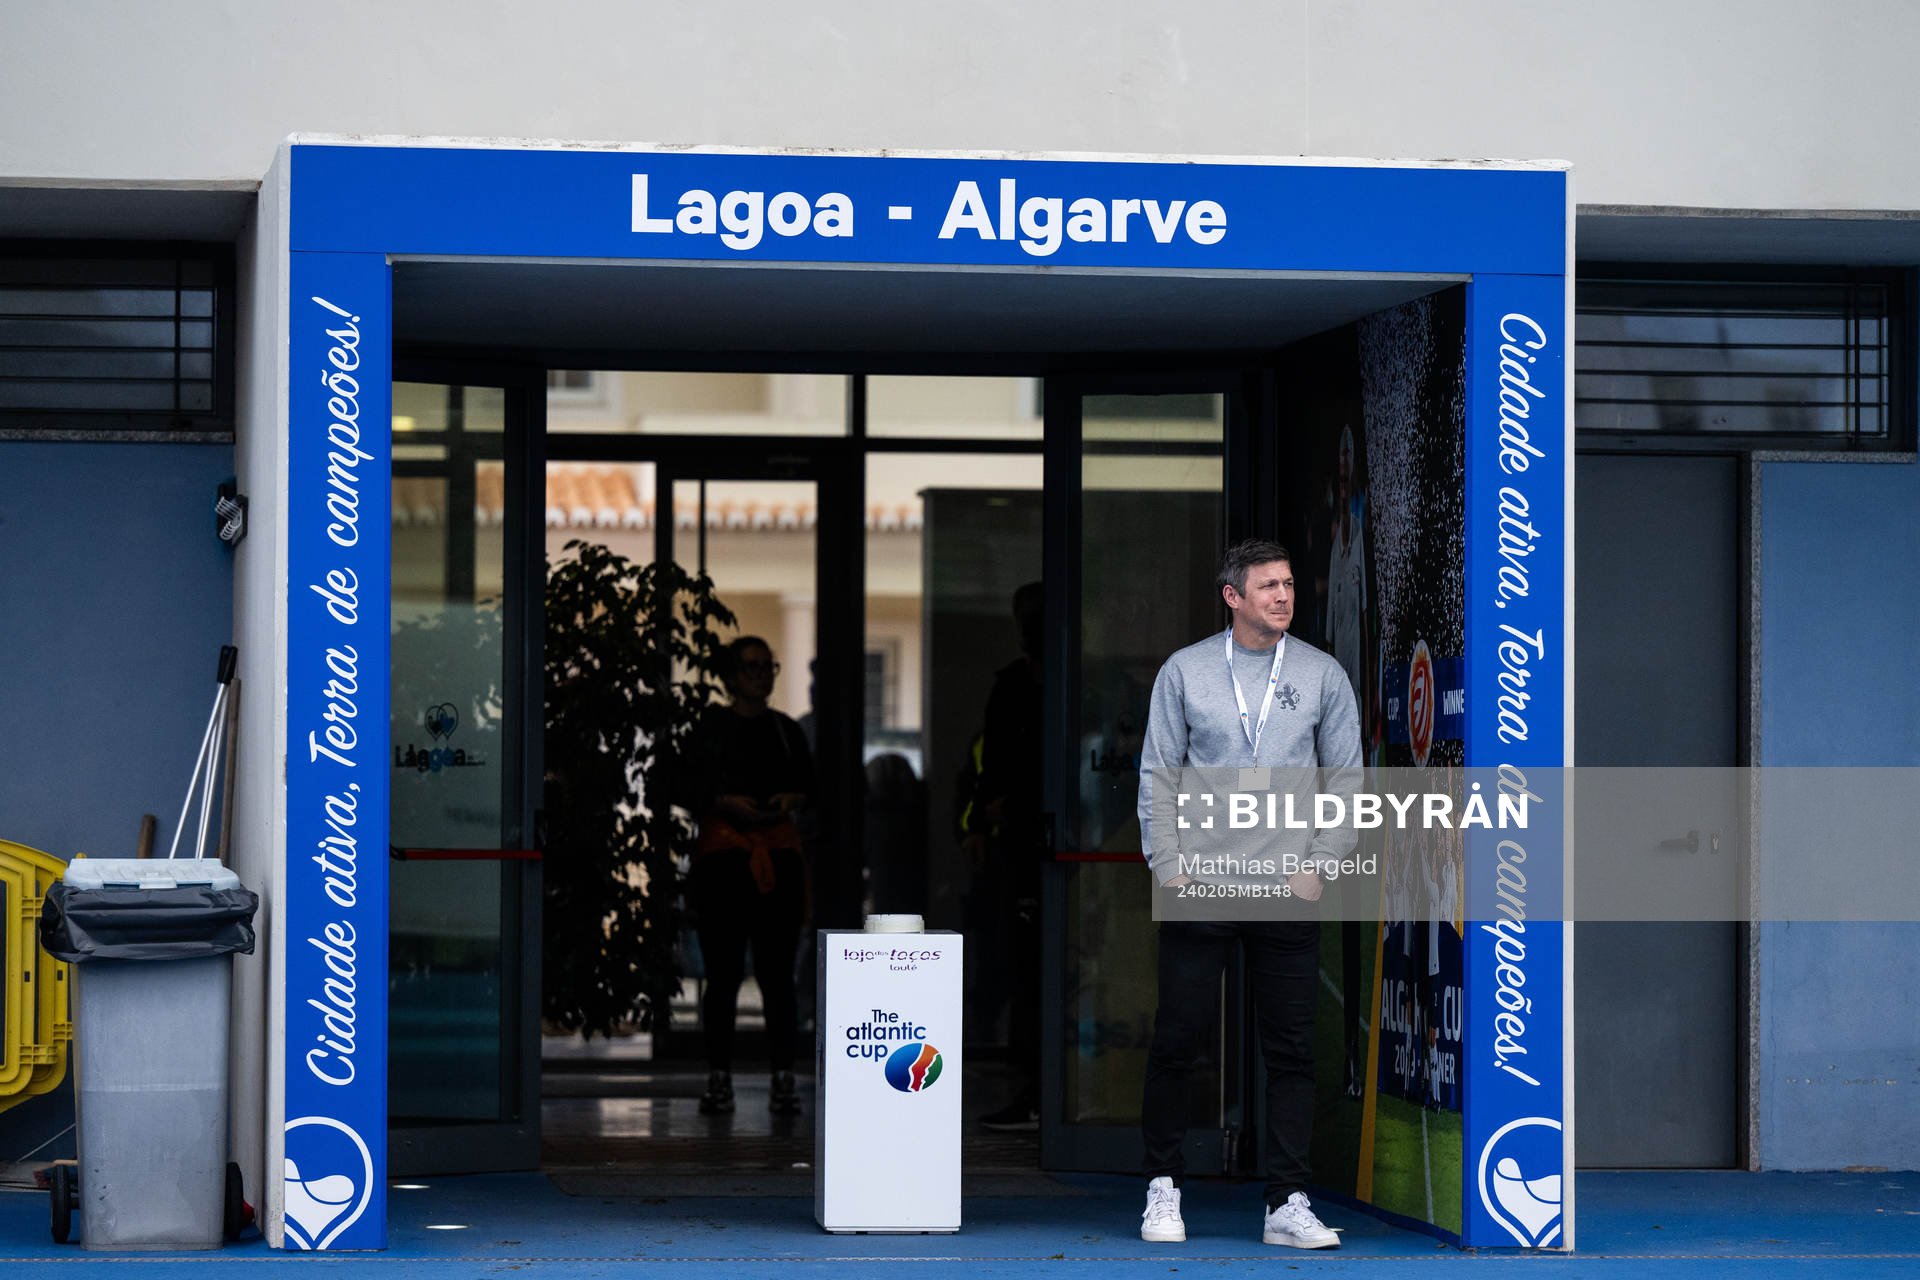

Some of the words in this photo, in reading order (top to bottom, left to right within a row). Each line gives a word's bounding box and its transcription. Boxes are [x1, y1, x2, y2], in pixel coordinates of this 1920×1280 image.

[631, 173, 854, 250] Lagoa
[938, 178, 1227, 256] Algarve
[311, 296, 375, 547] campeões!
[1498, 311, 1547, 475] Cidade
[309, 567, 360, 625] de
[1494, 486, 1542, 610] ativa,
[309, 644, 359, 768] Terra
[1497, 622, 1545, 744] Terra
[311, 782, 361, 908] ativa,
[306, 919, 357, 1086] Cidade
[872, 1009, 899, 1023] The
[1443, 984, 1464, 1044] CU
[1481, 839, 1541, 1087] campeões!
[846, 1021, 926, 1041] atlantic
[846, 1043, 888, 1062] cup
